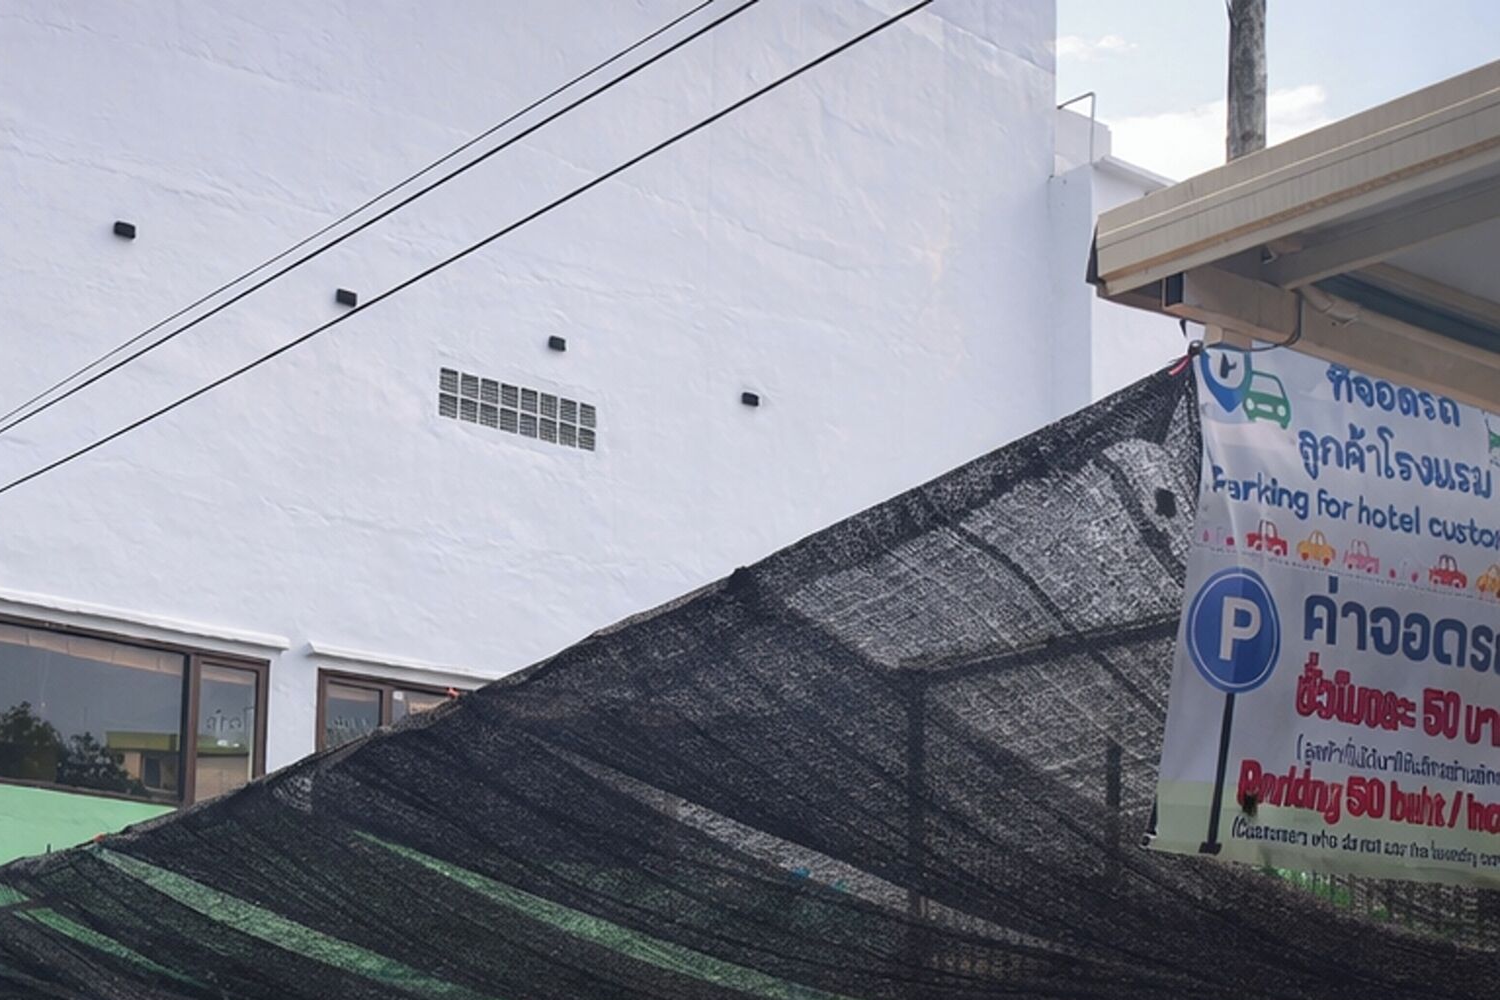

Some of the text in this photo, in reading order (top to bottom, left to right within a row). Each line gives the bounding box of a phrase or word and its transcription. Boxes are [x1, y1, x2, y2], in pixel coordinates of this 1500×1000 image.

[1317, 489, 1353, 520] for
[1359, 496, 1421, 535] hotel
[1428, 516, 1500, 551] custo
[1219, 596, 1262, 661] P
[1303, 575, 1500, 676] ค่าจอดร
[1422, 686, 1462, 740] 50
[1346, 775, 1386, 820] 50
